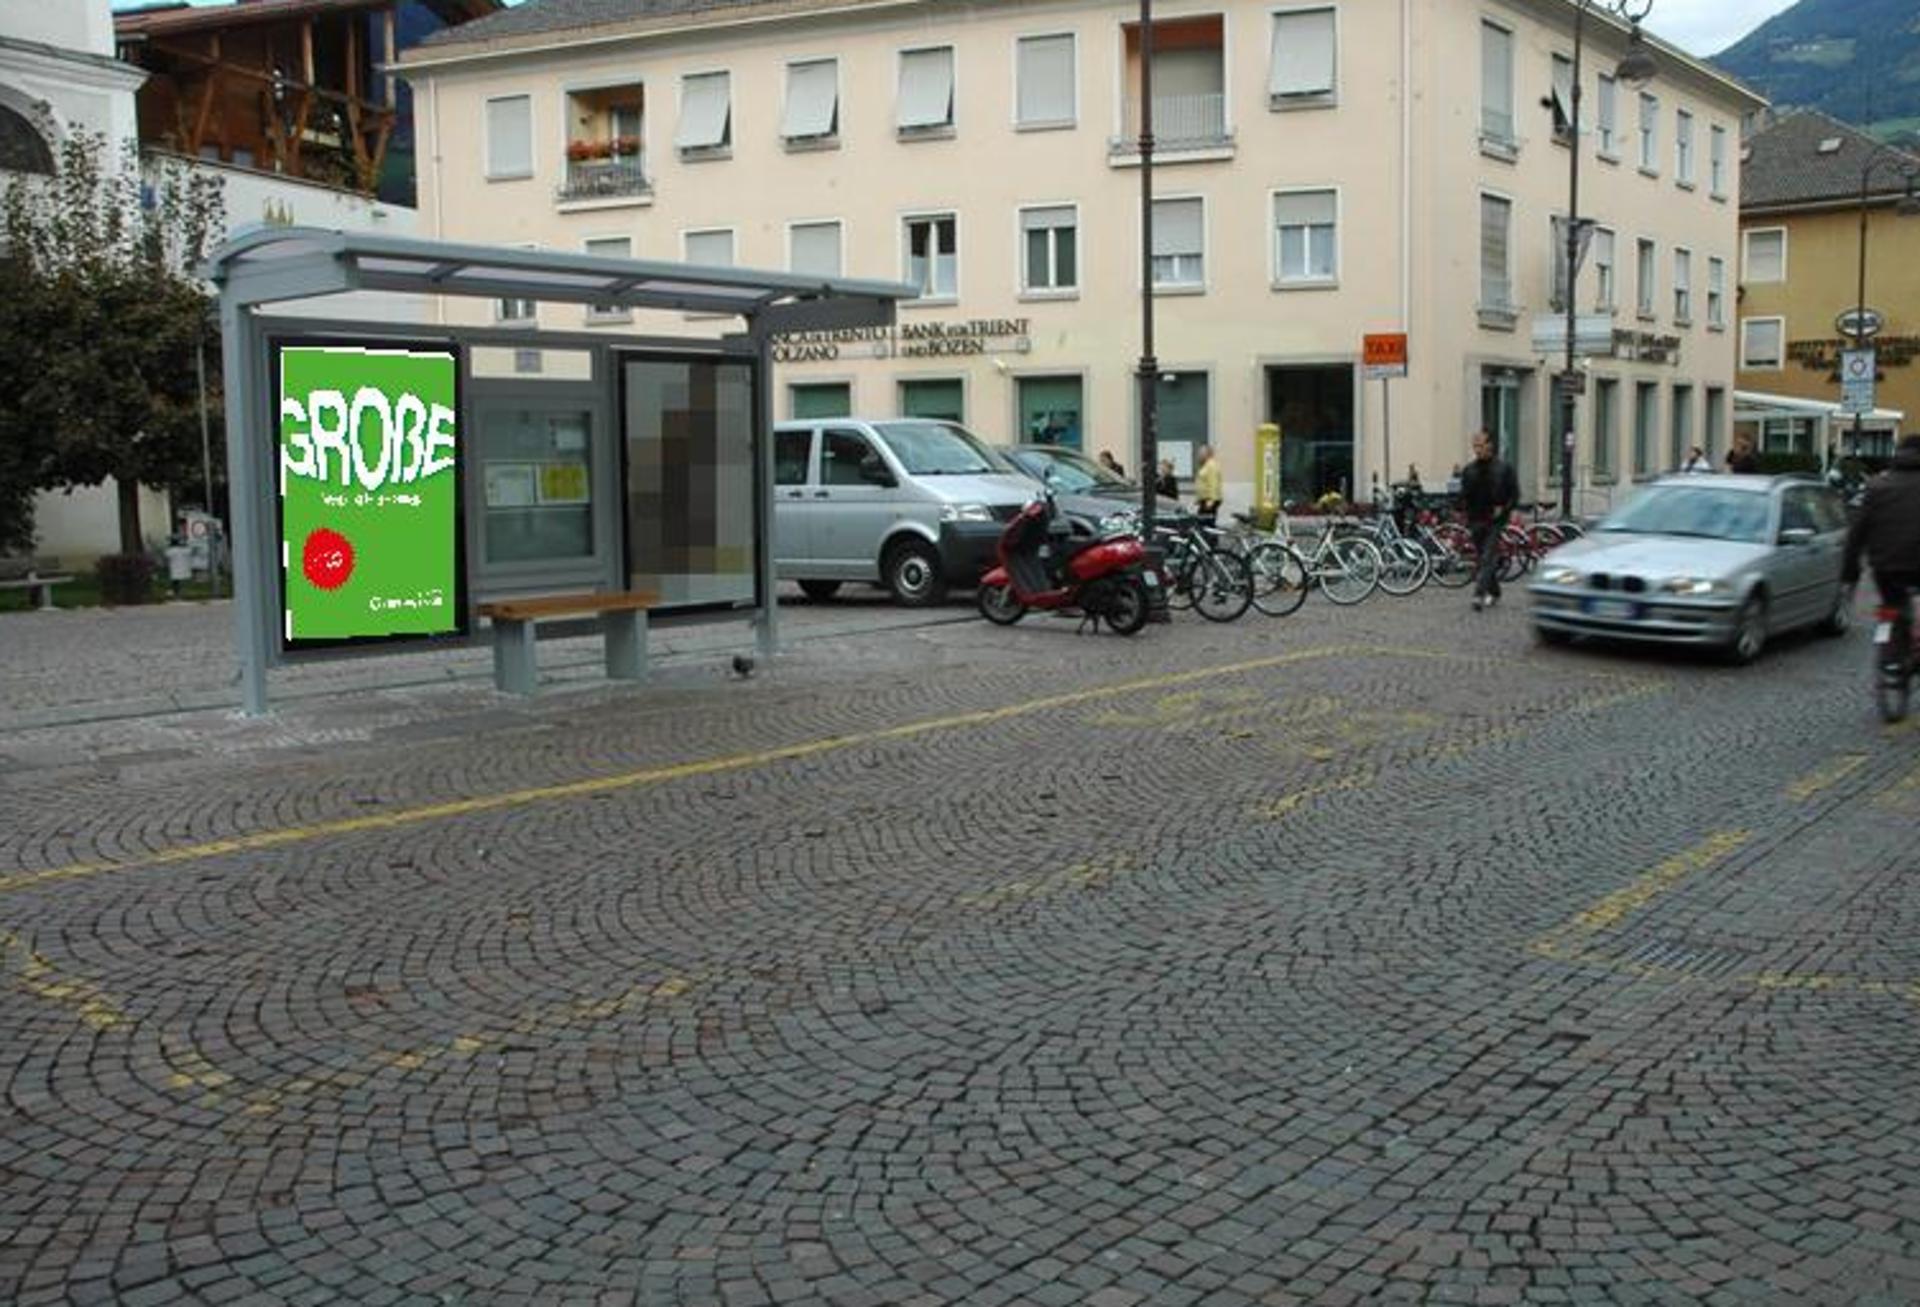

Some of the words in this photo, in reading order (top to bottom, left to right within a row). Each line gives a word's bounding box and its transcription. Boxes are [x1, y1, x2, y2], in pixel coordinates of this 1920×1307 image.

[901, 322, 945, 340] BANK
[967, 318, 1029, 337] TRIENT
[773, 345, 838, 362] OLZANO
[927, 339, 984, 358] BOZEN
[1365, 340, 1404, 354] TAXI
